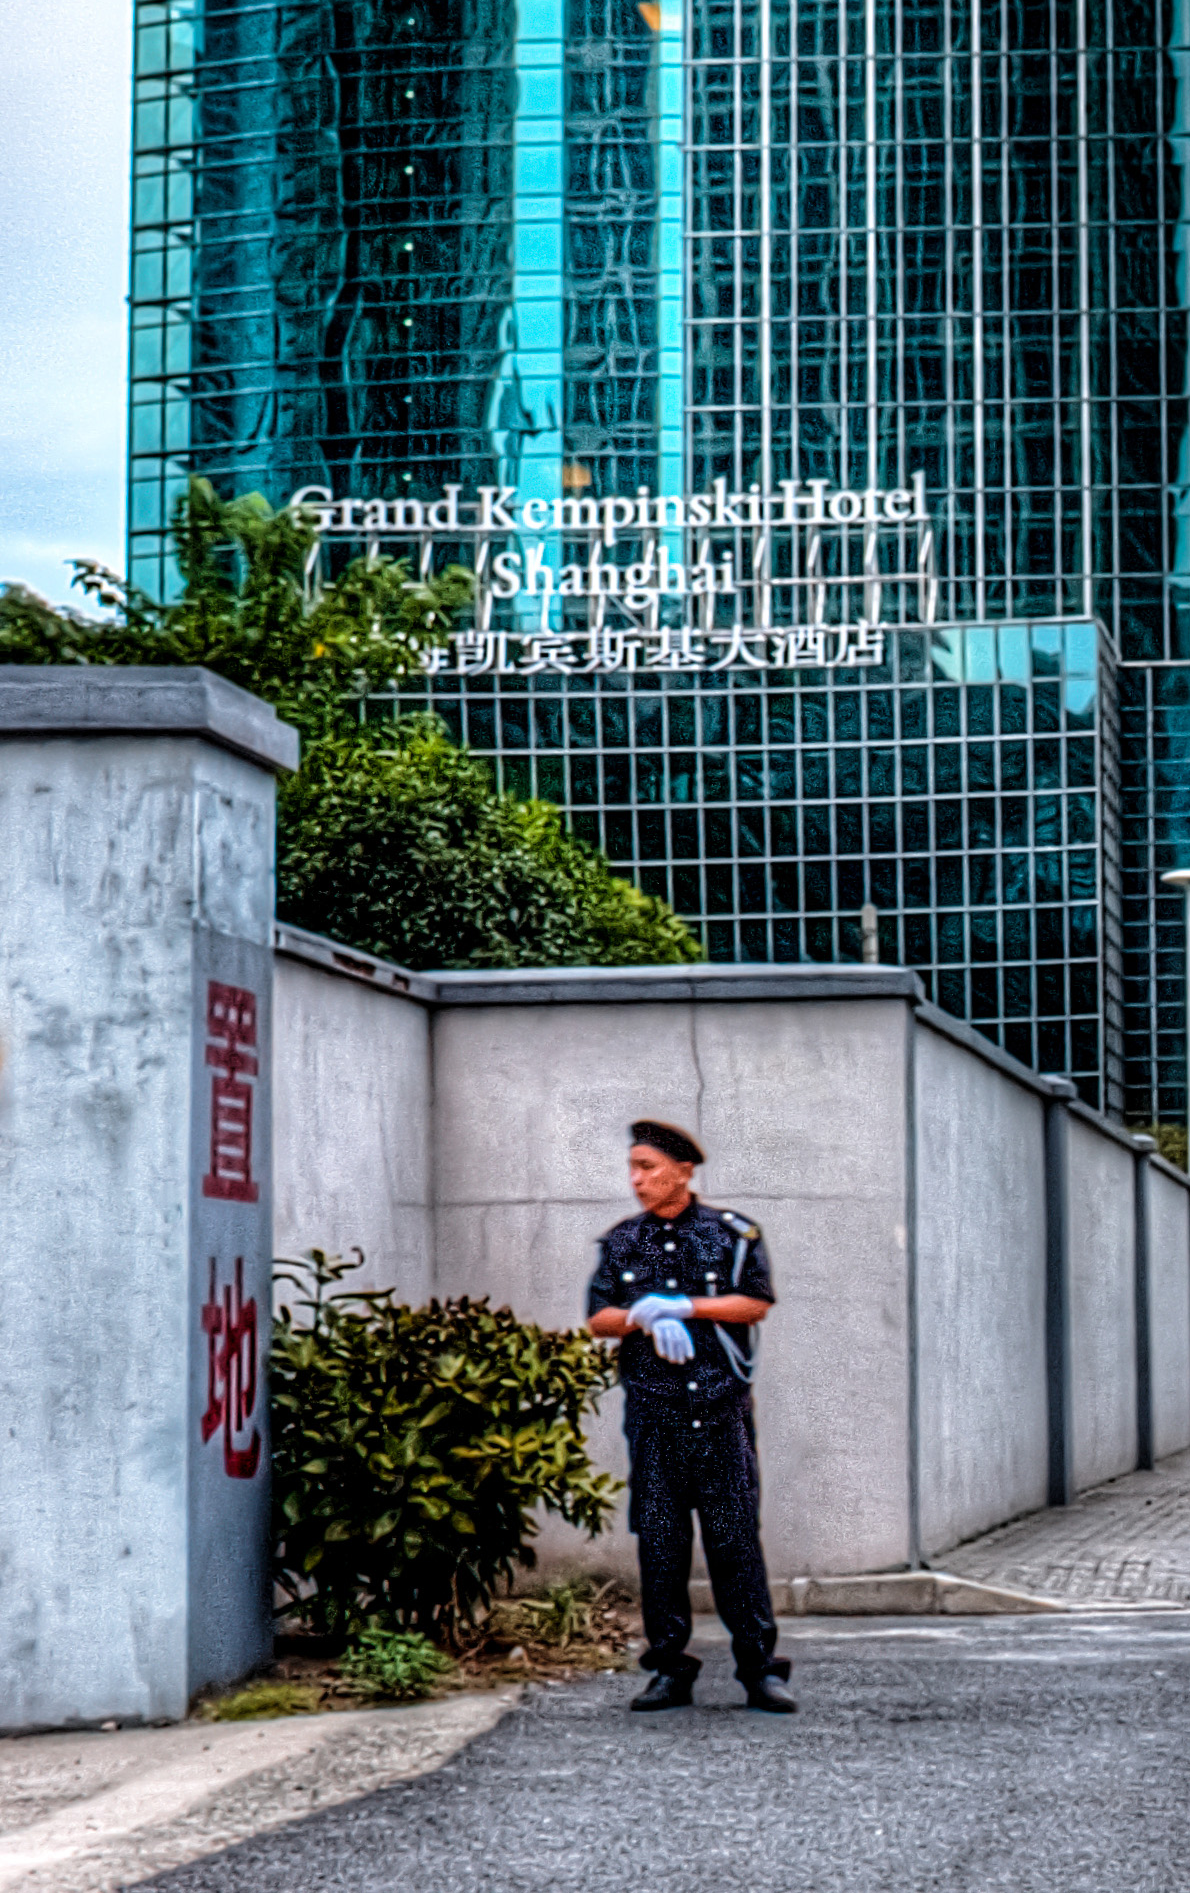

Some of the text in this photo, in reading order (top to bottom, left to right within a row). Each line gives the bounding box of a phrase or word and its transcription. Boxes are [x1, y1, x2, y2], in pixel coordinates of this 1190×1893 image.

[289, 469, 931, 547] Grand Kempinski Hotel
[491, 543, 740, 610] Shanghai
